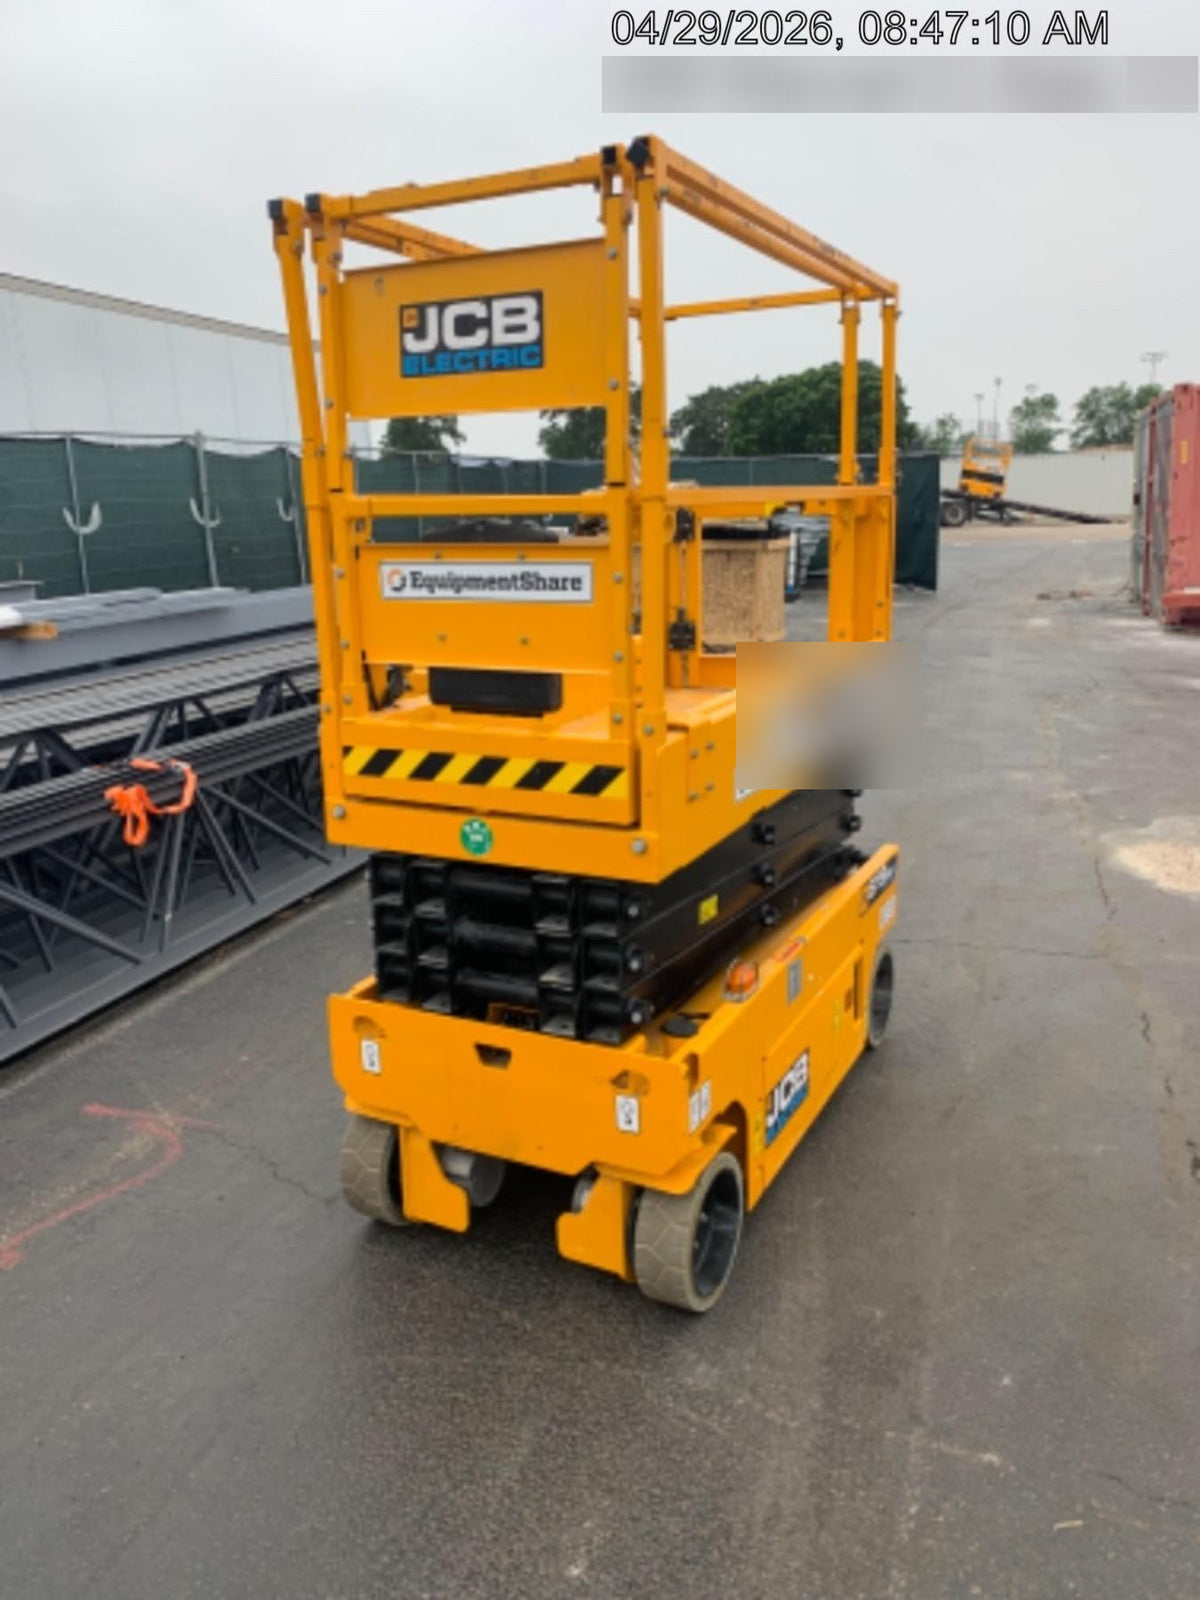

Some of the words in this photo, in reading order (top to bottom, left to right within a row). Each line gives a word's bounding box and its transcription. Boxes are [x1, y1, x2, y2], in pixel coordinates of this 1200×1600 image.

[402, 295, 541, 353] JCB
[402, 345, 542, 376] ELECTRIC
[409, 571, 583, 594] EquipmentShare
[766, 1052, 808, 1128] JCB
